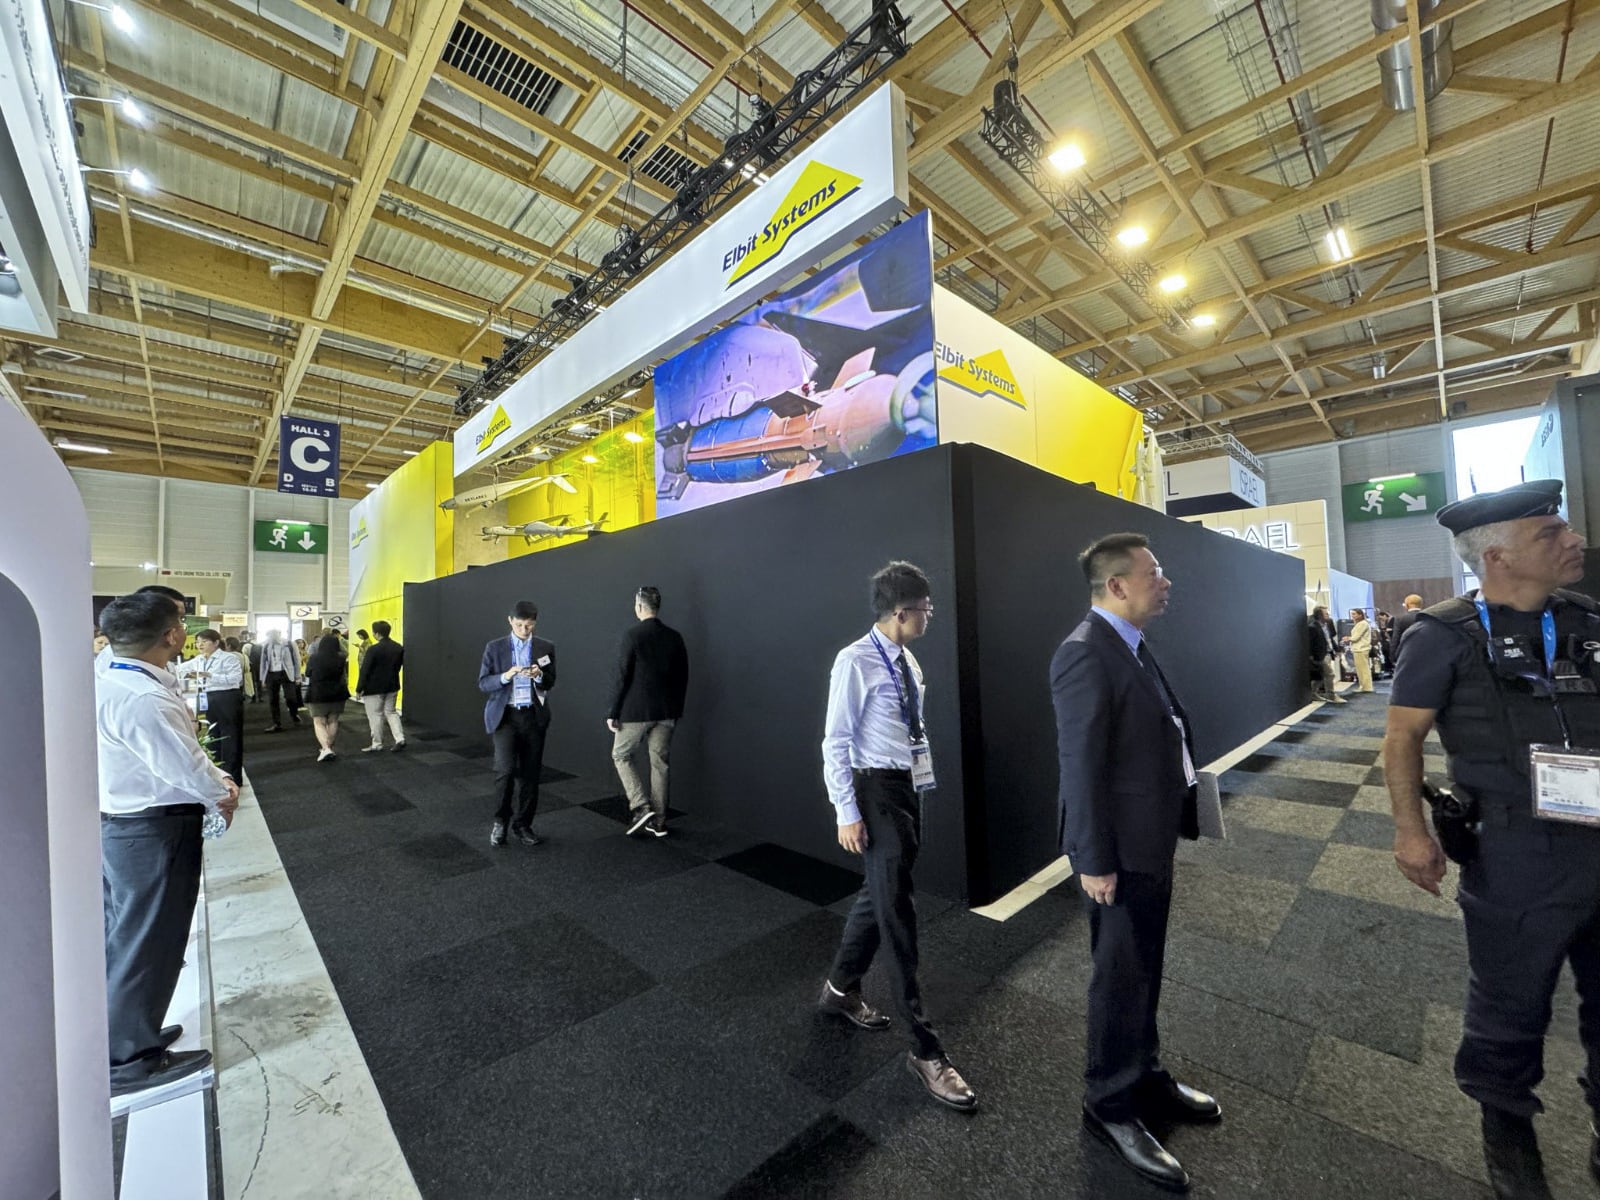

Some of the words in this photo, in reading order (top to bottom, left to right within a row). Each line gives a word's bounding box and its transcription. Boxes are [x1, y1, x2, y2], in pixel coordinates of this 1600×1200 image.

[723, 233, 757, 272] Elbit
[762, 179, 836, 243] Systems
[936, 341, 965, 369] Elbit
[968, 358, 1015, 394] Systems
[291, 425, 320, 435] HALL
[290, 437, 331, 472] C
[283, 473, 294, 482] D
[325, 478, 335, 487] B
